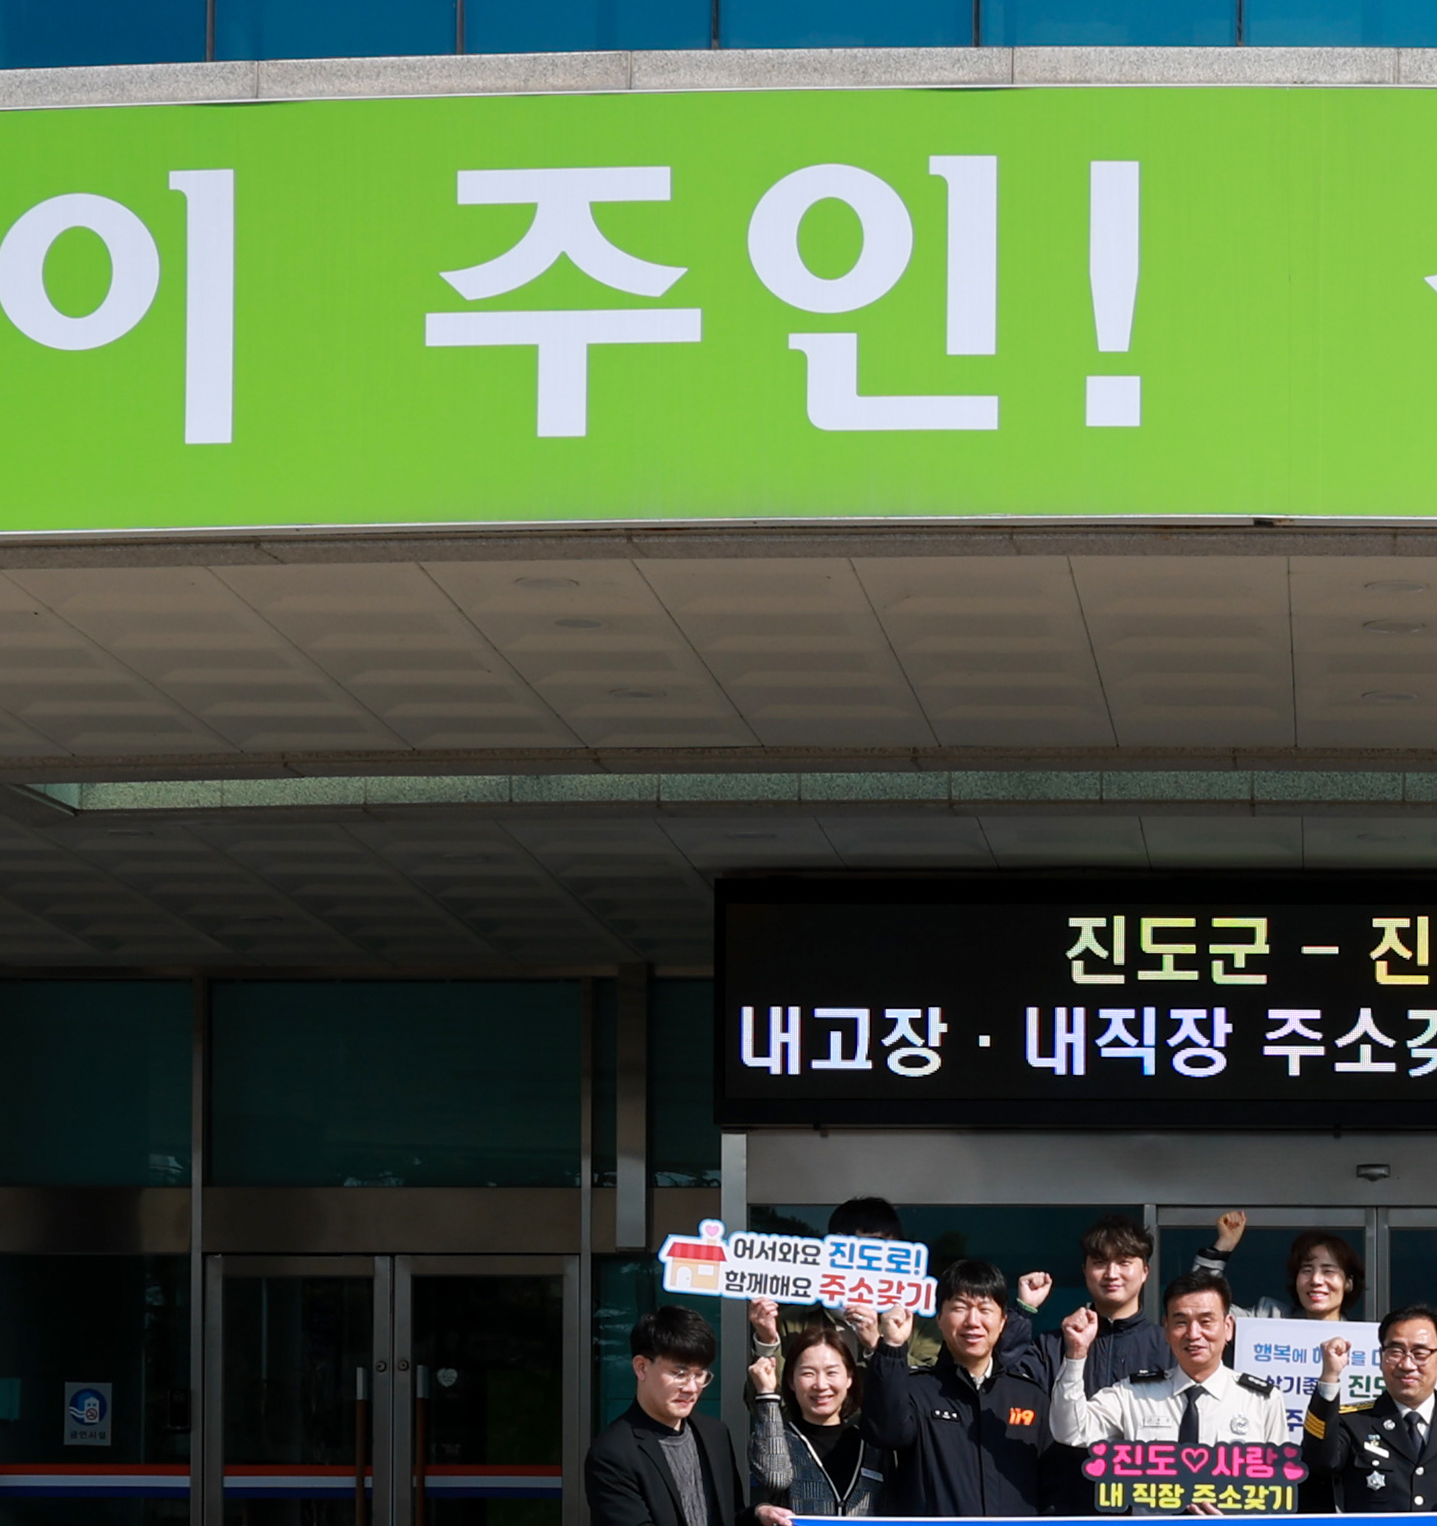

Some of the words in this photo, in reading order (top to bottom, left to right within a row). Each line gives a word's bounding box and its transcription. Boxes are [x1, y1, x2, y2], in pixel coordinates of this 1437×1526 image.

[424, 154, 1141, 438] 주인!
[1066, 914, 1271, 986] 진도군
[741, 1005, 949, 1078] 내고장
[1025, 1005, 1233, 1078] 내직장
[733, 1237, 822, 1266] 어서와요
[828, 1241, 923, 1277] 진도로!
[725, 1270, 812, 1299] 함께해요
[819, 1273, 933, 1311] 주소갖기
[1253, 1343, 1307, 1363] 행복에
[1009, 1407, 1035, 1426] 119
[1112, 1444, 1178, 1476] 진도
[1211, 1445, 1279, 1478] 사랑
[1099, 1482, 1124, 1508] 내
[1132, 1483, 1185, 1509] 직장
[1191, 1483, 1293, 1511] 주소갖기
